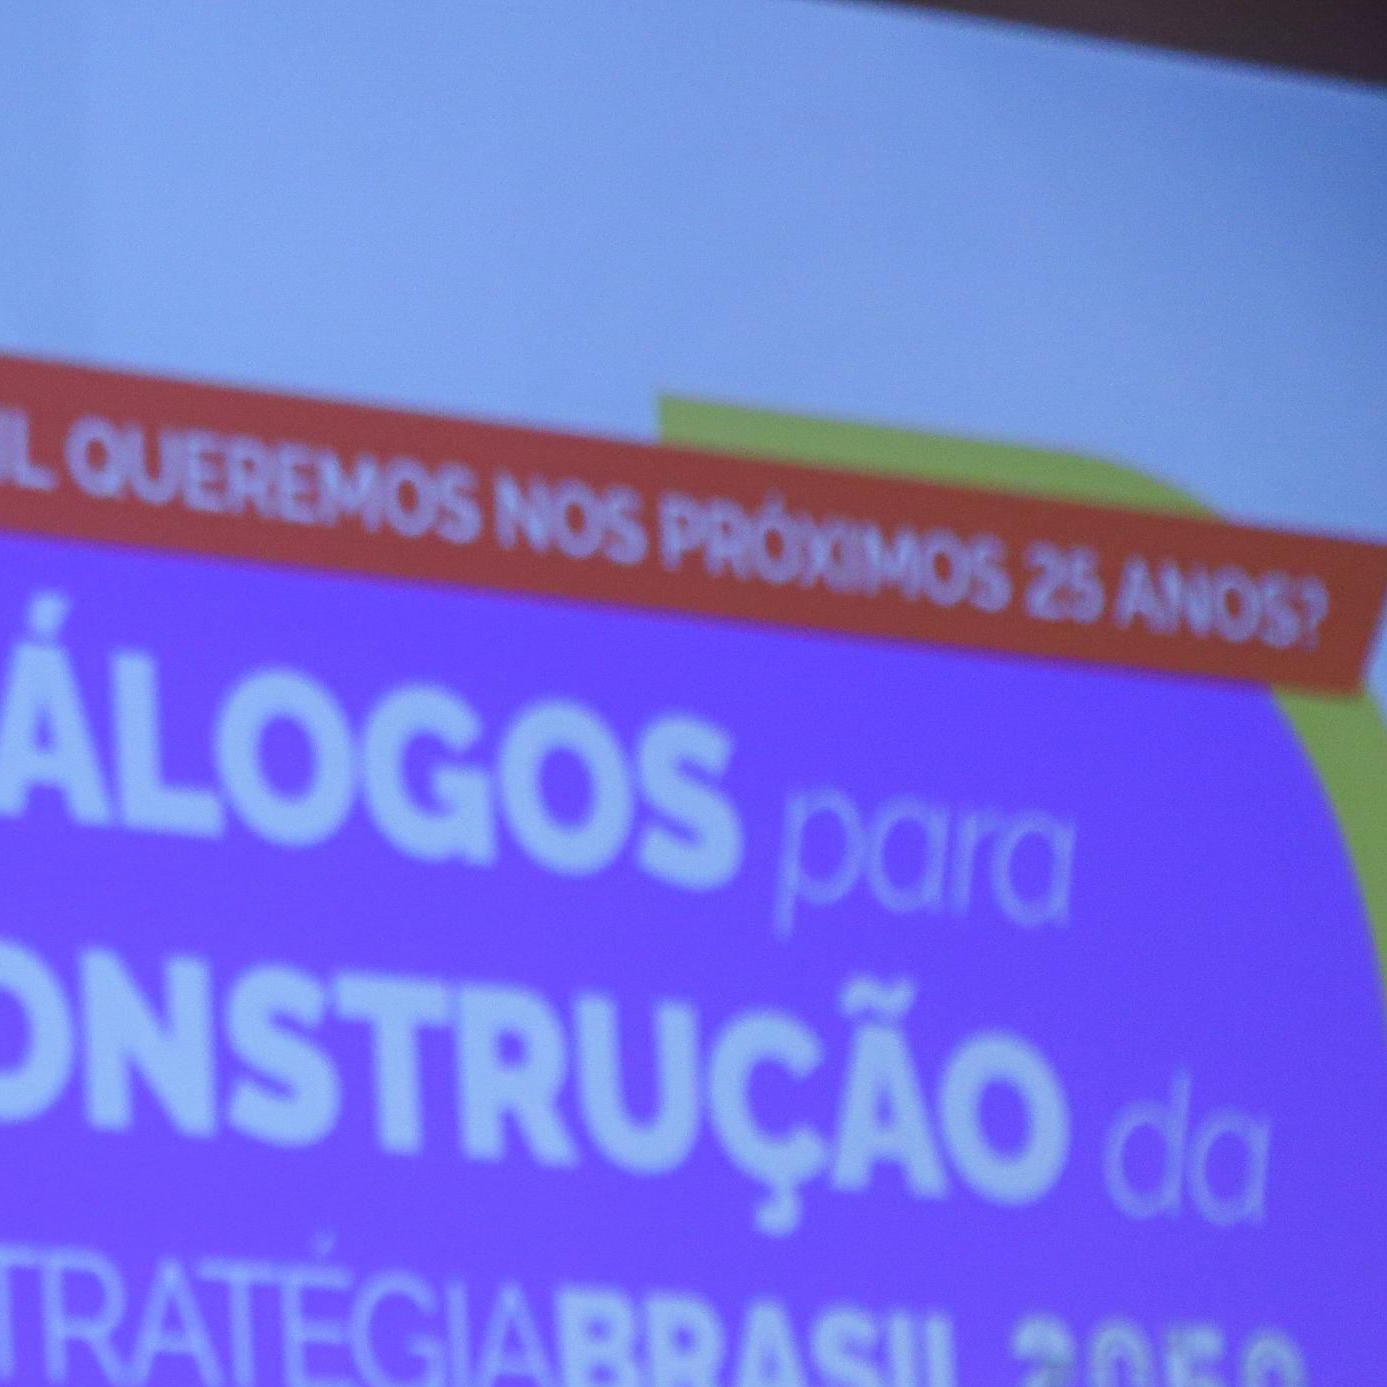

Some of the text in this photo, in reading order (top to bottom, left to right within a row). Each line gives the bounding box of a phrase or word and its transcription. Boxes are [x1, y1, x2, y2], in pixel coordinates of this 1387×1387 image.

[63, 413, 483, 547] QUEREMOS
[491, 471, 649, 566] NOS
[657, 488, 1014, 615] PRÓXIMOS
[1022, 538, 1106, 627] 25
[1113, 553, 1331, 652] ANOS?
[772, 785, 1079, 942] para
[1101, 1070, 1272, 1230] da
